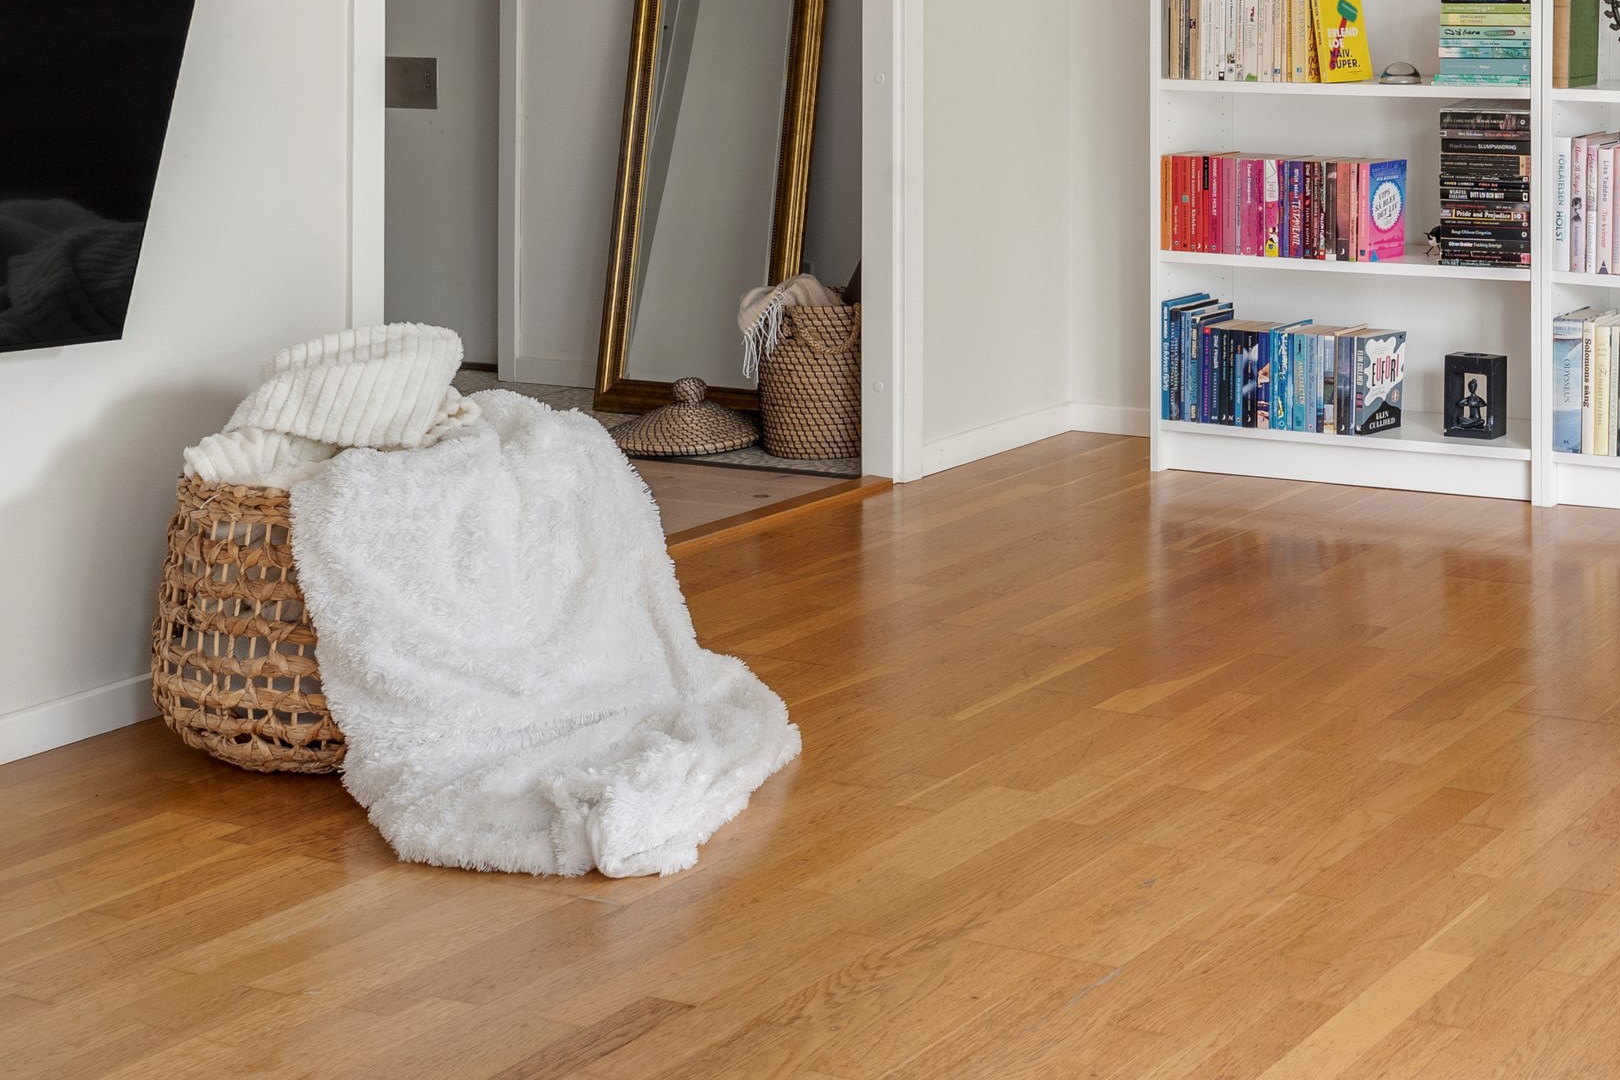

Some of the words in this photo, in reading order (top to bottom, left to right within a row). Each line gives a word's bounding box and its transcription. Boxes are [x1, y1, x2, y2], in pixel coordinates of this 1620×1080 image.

[1327, 27, 1358, 38] ERLEND
[1328, 39, 1344, 48] LOE
[1330, 49, 1352, 58] NAIV.
[1330, 59, 1360, 69] SUPER.
[1378, 188, 1390, 200] VIPS
[1383, 194, 1396, 208] BLEV
[1377, 208, 1388, 220] DET
[1389, 202, 1398, 212] LIV
[1292, 200, 1301, 246] TESTAMENTE
[1372, 353, 1399, 386] EUFORI
[1376, 411, 1389, 421] ELIN
[1369, 417, 1396, 429] CULLHED
